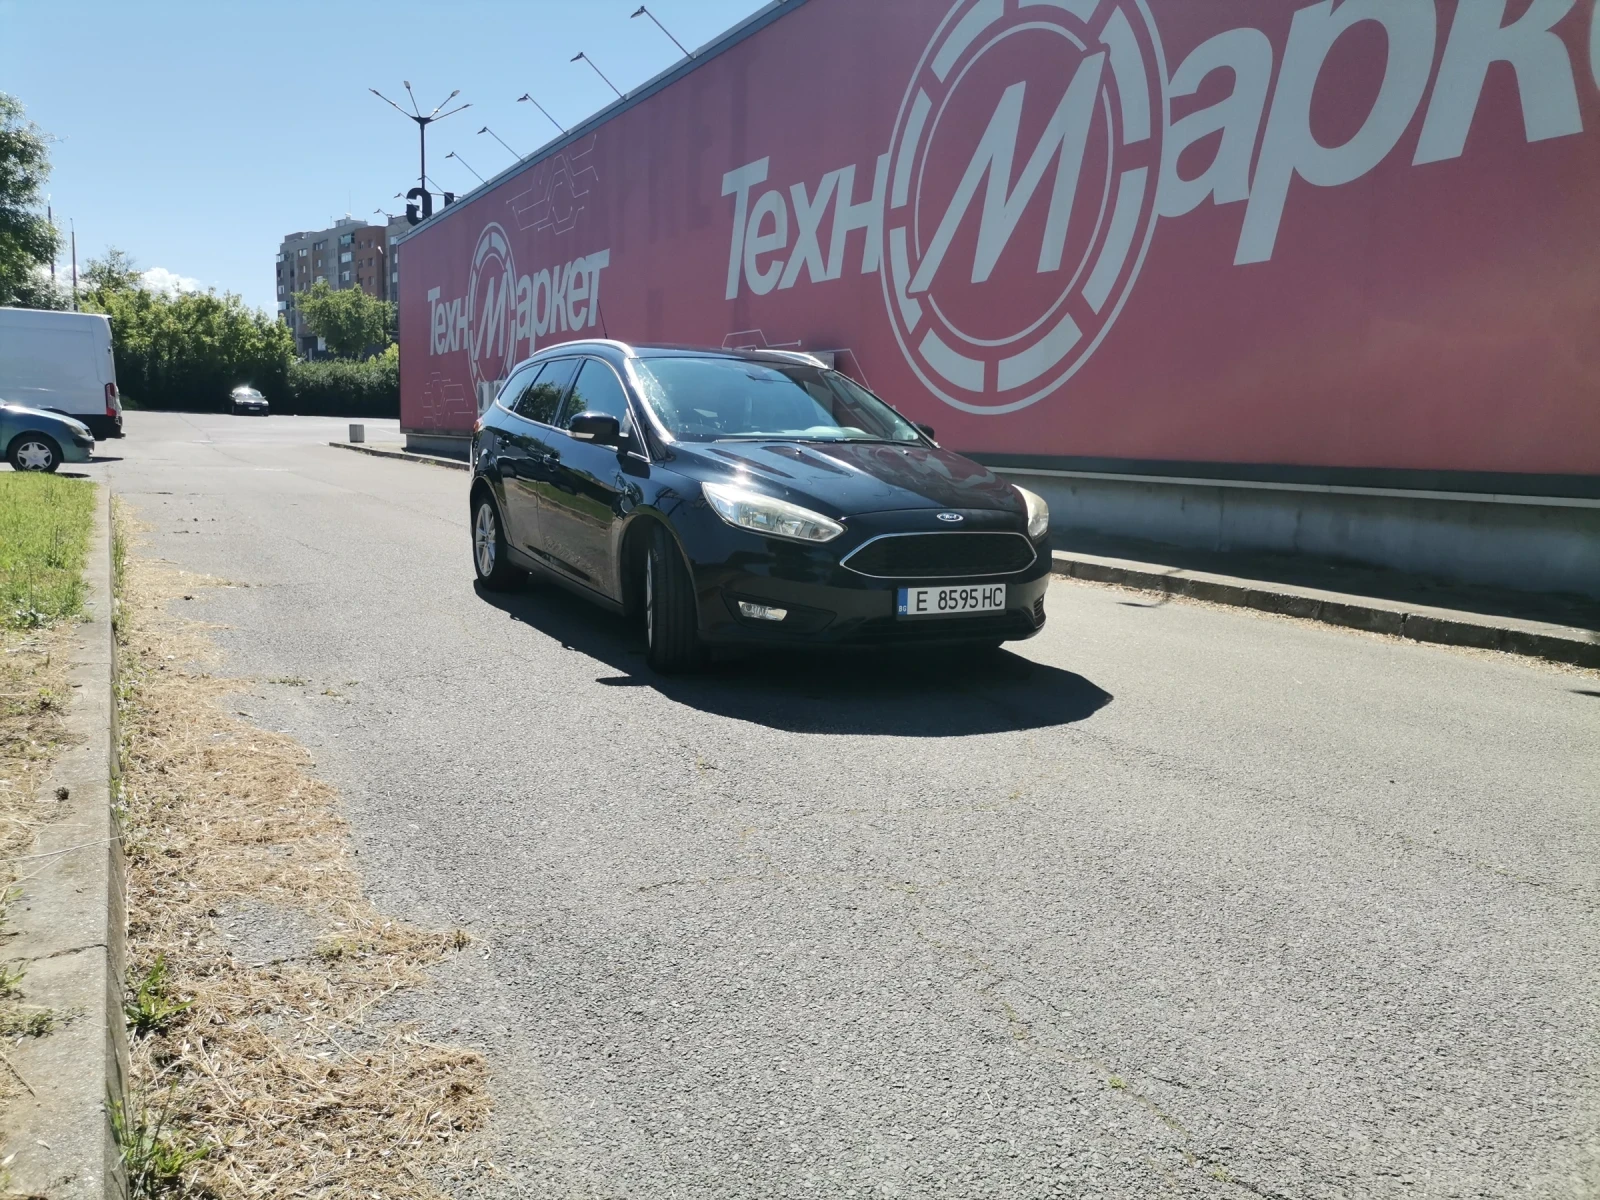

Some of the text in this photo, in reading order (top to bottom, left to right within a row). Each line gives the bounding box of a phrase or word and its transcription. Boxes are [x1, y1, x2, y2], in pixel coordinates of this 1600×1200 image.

[916, 587, 1003, 611] E 8595 HC
